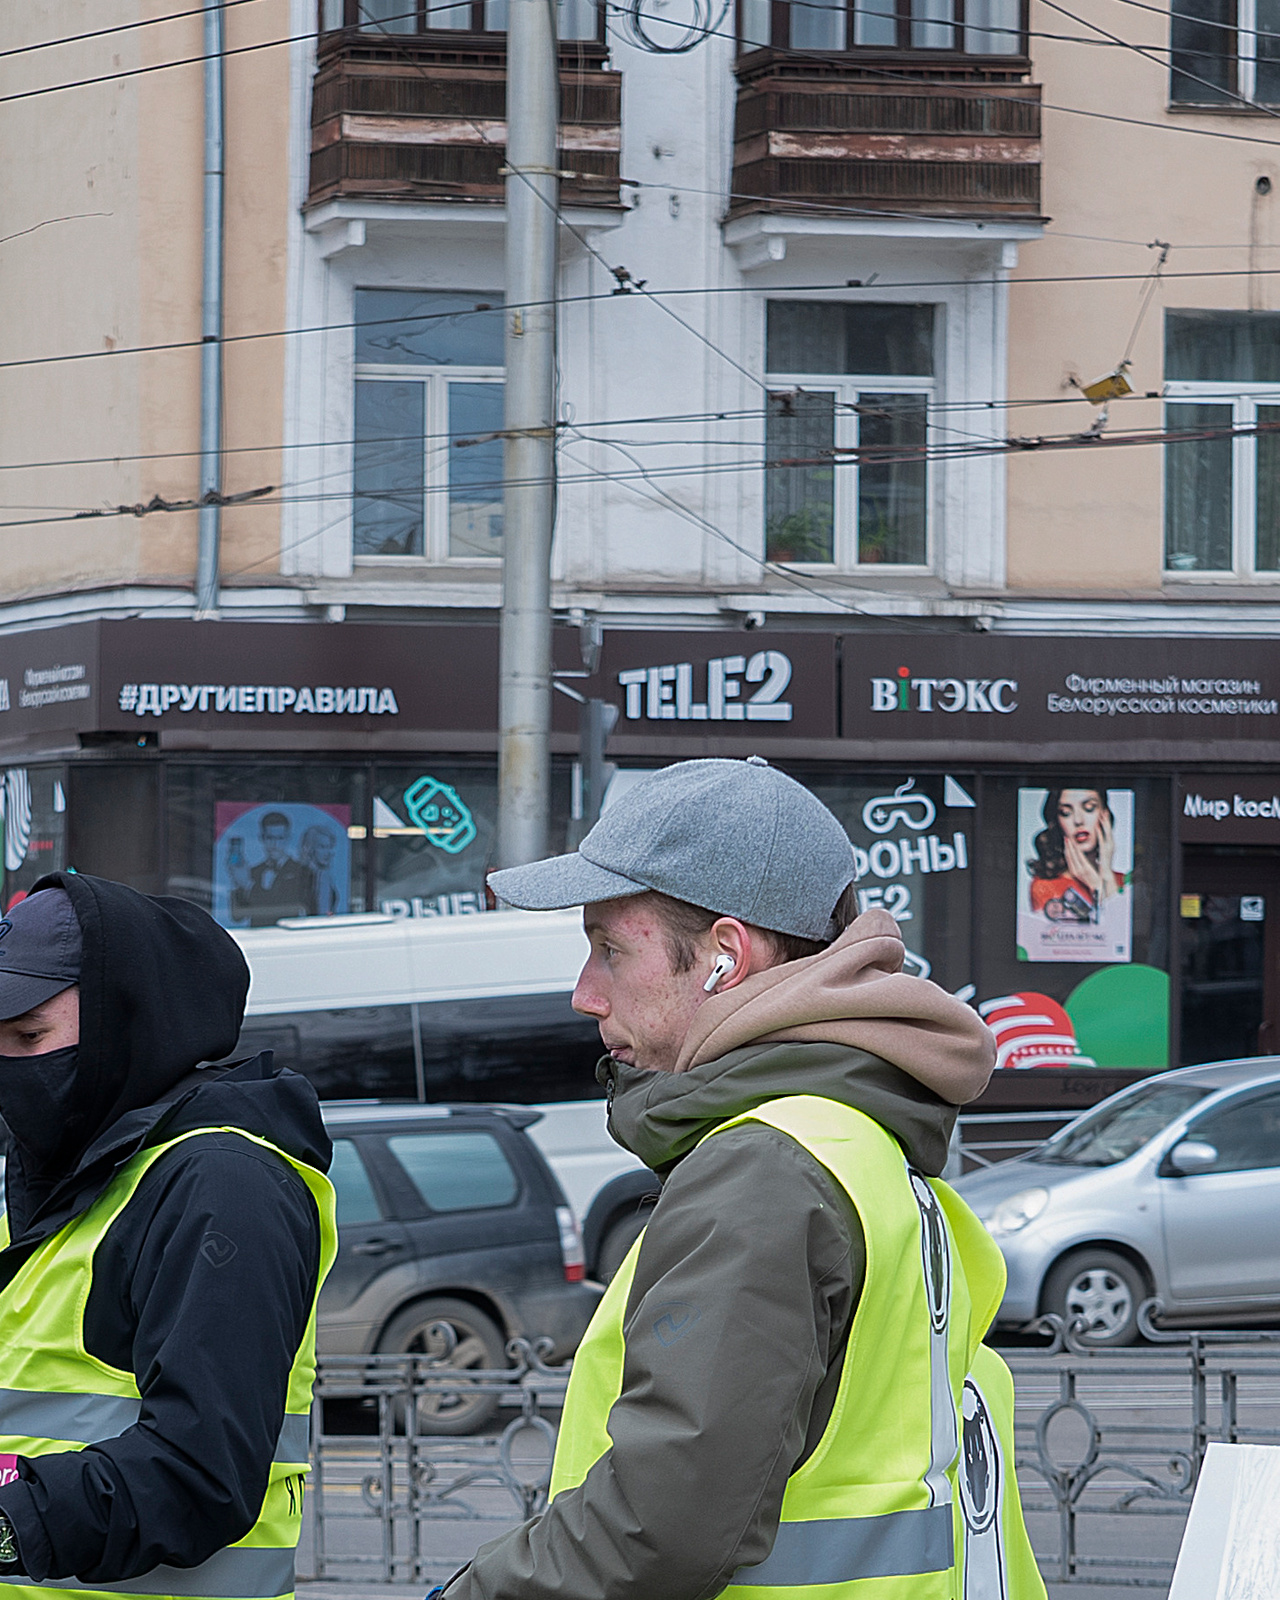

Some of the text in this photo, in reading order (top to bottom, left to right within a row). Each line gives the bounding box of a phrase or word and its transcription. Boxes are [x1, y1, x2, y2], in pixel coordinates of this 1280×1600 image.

[619, 650, 792, 721] TELE2
[1065, 673, 1261, 695] Фирменный магазин
[119, 684, 399, 716] #ДРУГИЕПРАВИЛА
[1047, 693, 1280, 716] Белорусской косметики
[1183, 793, 1230, 820] Мир
